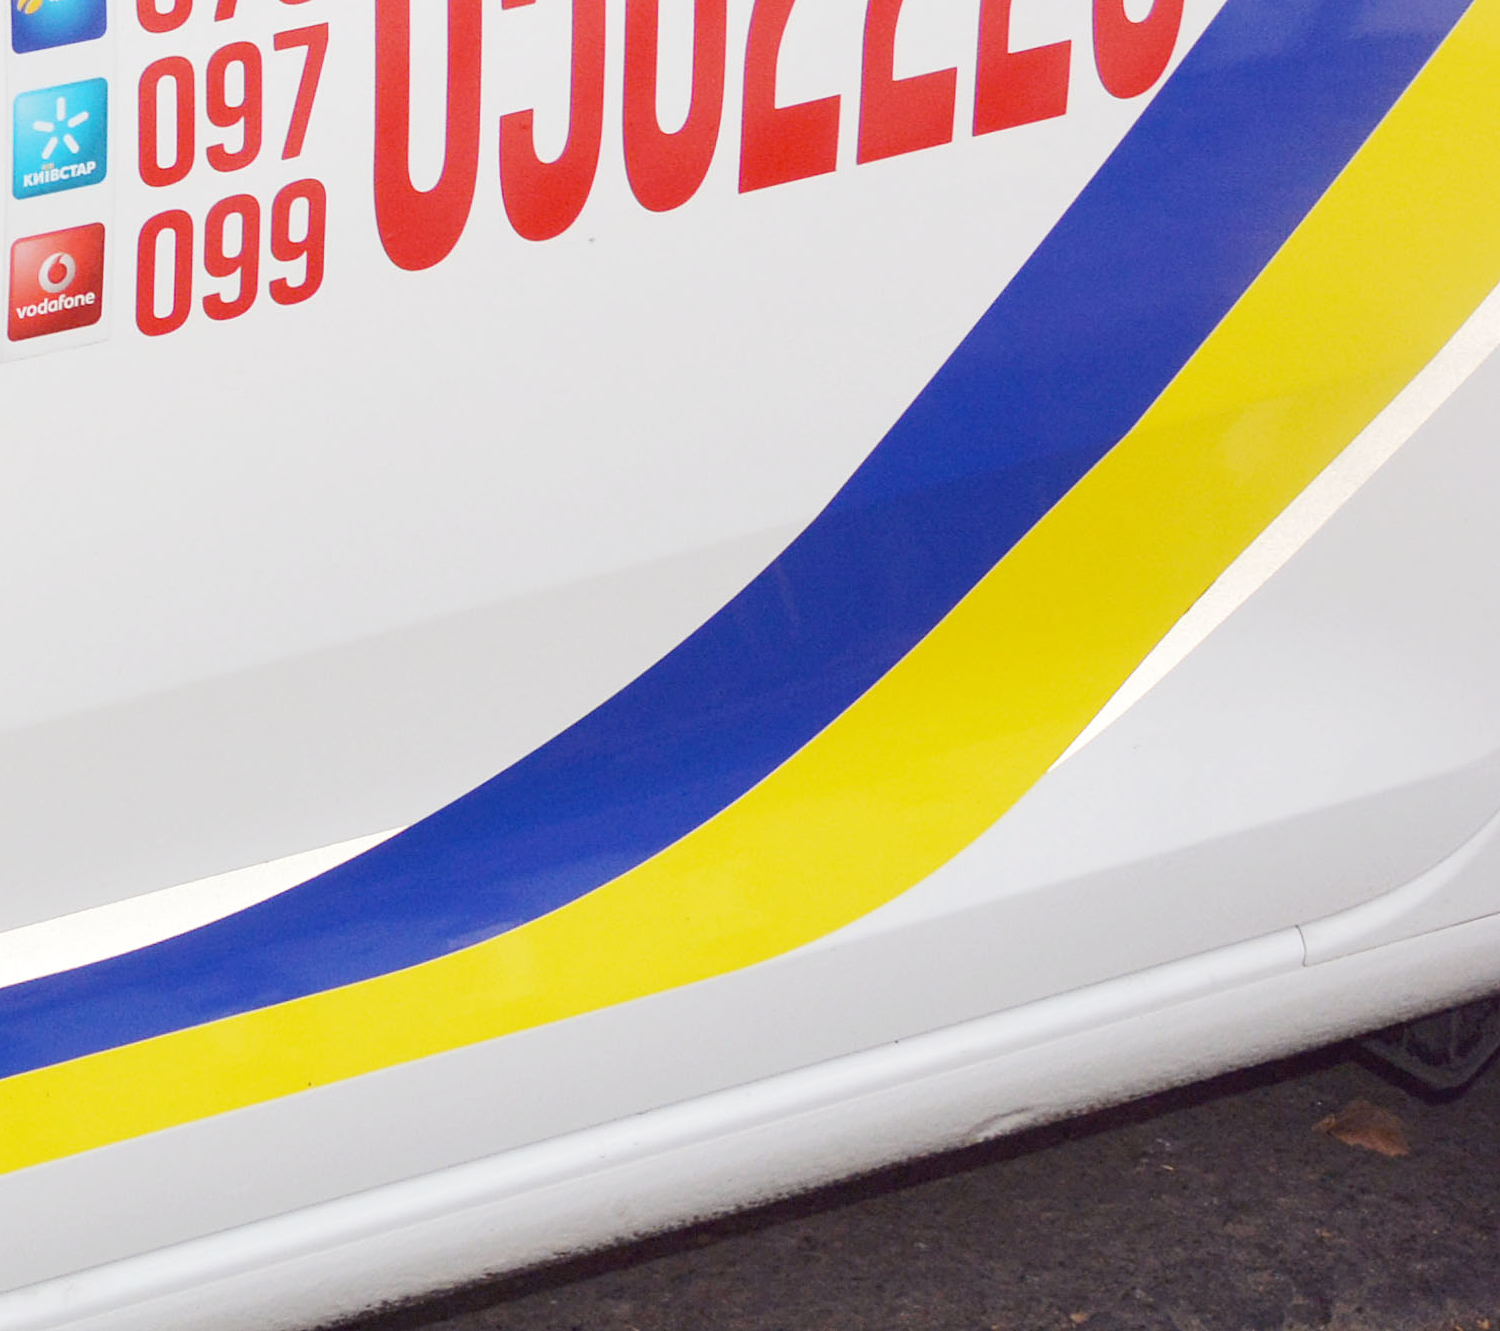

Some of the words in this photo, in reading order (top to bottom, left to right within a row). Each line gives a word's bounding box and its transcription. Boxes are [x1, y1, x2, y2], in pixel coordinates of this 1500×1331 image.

[138, 22, 329, 188] 097
[23, 160, 97, 188] КИЇВСТАР
[135, 178, 327, 337] 099
[16, 291, 96, 319] vodafone
